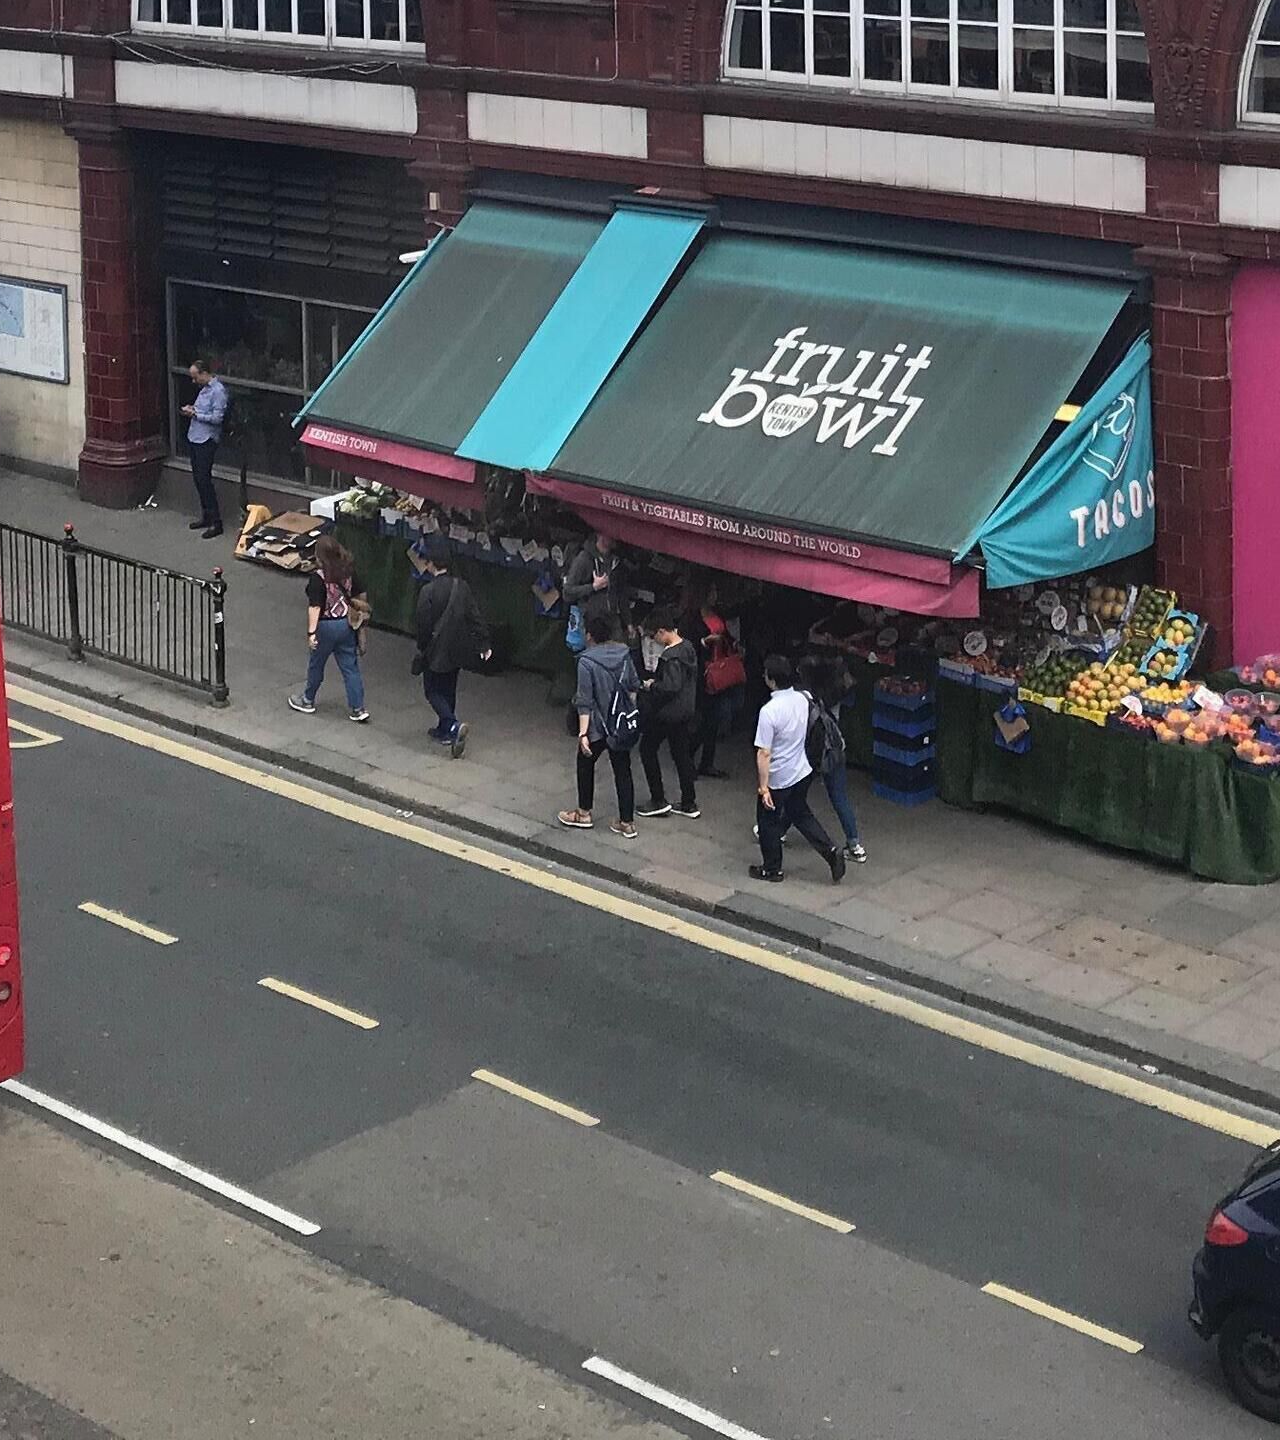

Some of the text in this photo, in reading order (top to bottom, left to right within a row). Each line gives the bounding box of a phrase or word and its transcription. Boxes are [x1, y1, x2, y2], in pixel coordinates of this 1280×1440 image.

[750, 326, 933, 406] fruit
[308, 427, 377, 454] KENTISH TOWN
[696, 366, 925, 457] bowl
[766, 415, 797, 433] TOWN
[768, 401, 814, 419] KENTISH
[601, 493, 862, 560] FRUIT & VEGETABLES FROM AROUND THE WORLD
[1069, 470, 1155, 548] TACOS
